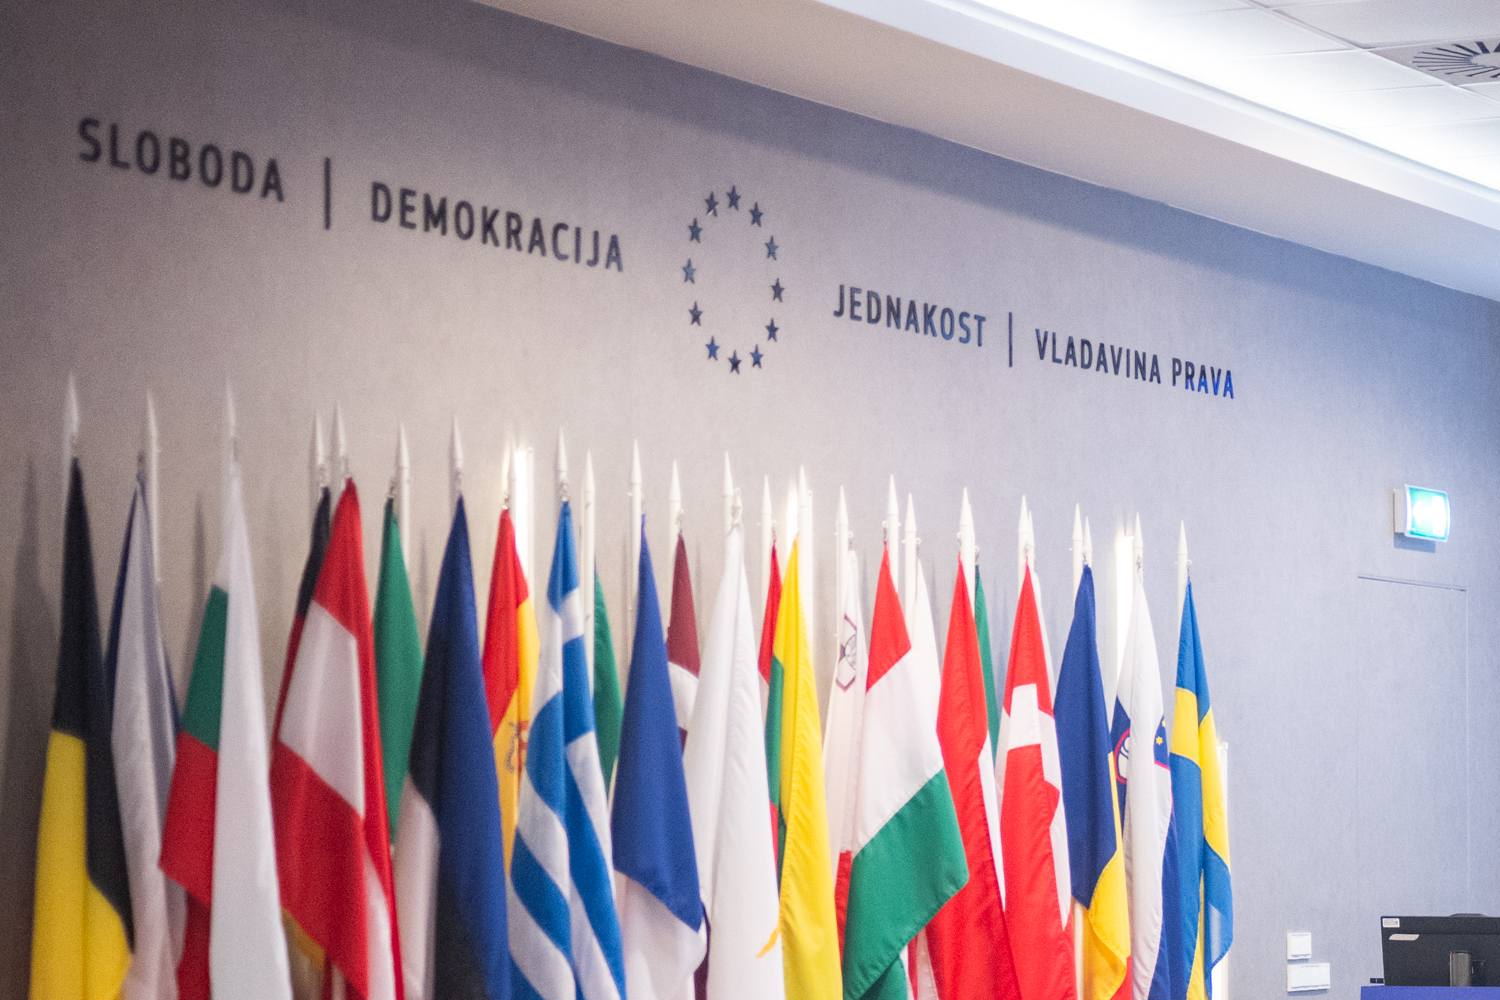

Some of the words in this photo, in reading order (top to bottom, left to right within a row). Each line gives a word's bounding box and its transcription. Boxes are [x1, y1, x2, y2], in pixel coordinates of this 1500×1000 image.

[79, 117, 285, 202] SLOBODA
[371, 181, 624, 272] DEMOKRACIJA
[833, 284, 987, 347] JEDNAKOST
[1035, 328, 1161, 384] VLADAVINA
[1172, 358, 1235, 399] PRAVA
